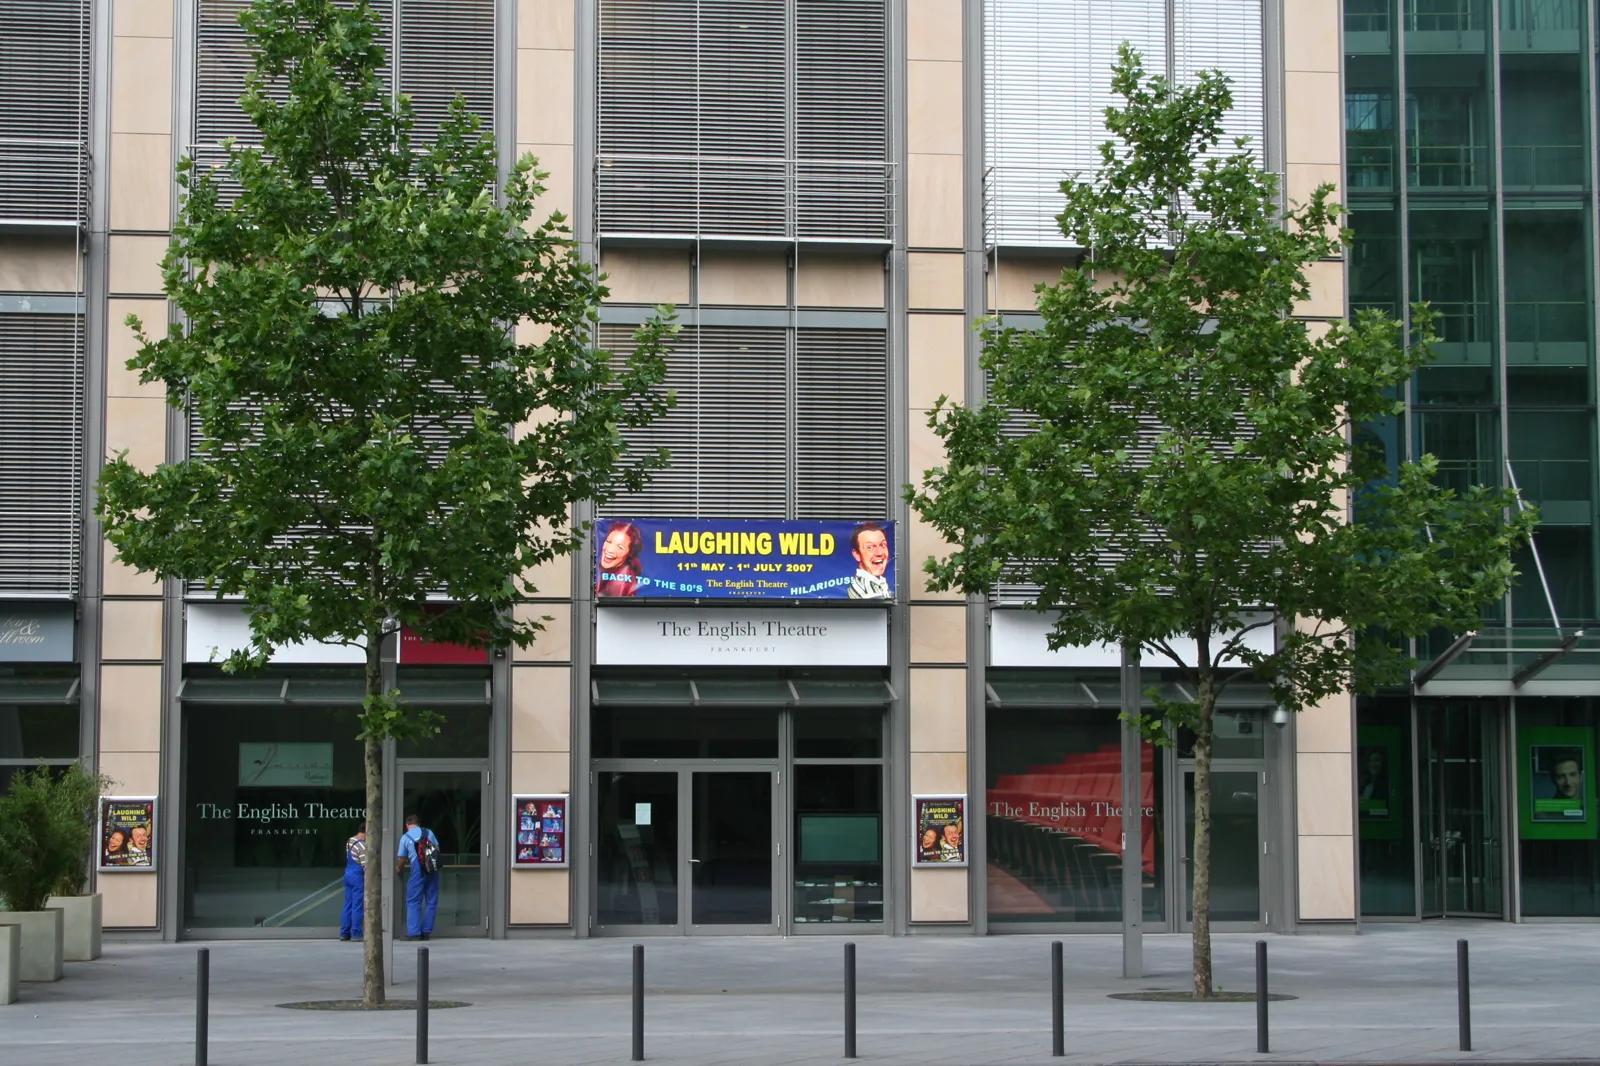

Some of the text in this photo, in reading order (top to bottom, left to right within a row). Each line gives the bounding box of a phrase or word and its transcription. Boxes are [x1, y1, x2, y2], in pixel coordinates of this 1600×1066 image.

[655, 531, 835, 556] LAUGHING WILD
[677, 563, 698, 571] 11th
[701, 563, 725, 571] MAY
[737, 564, 750, 572] 1st
[753, 564, 782, 572] JULY
[786, 564, 813, 572] 2007
[602, 573, 703, 593] BACK TO THE 80'S
[706, 580, 788, 590] The English Theatre
[657, 621, 828, 641] The English Theatre
[197, 804, 232, 818] The
[236, 804, 299, 823] English
[990, 802, 1154, 820] The English There
